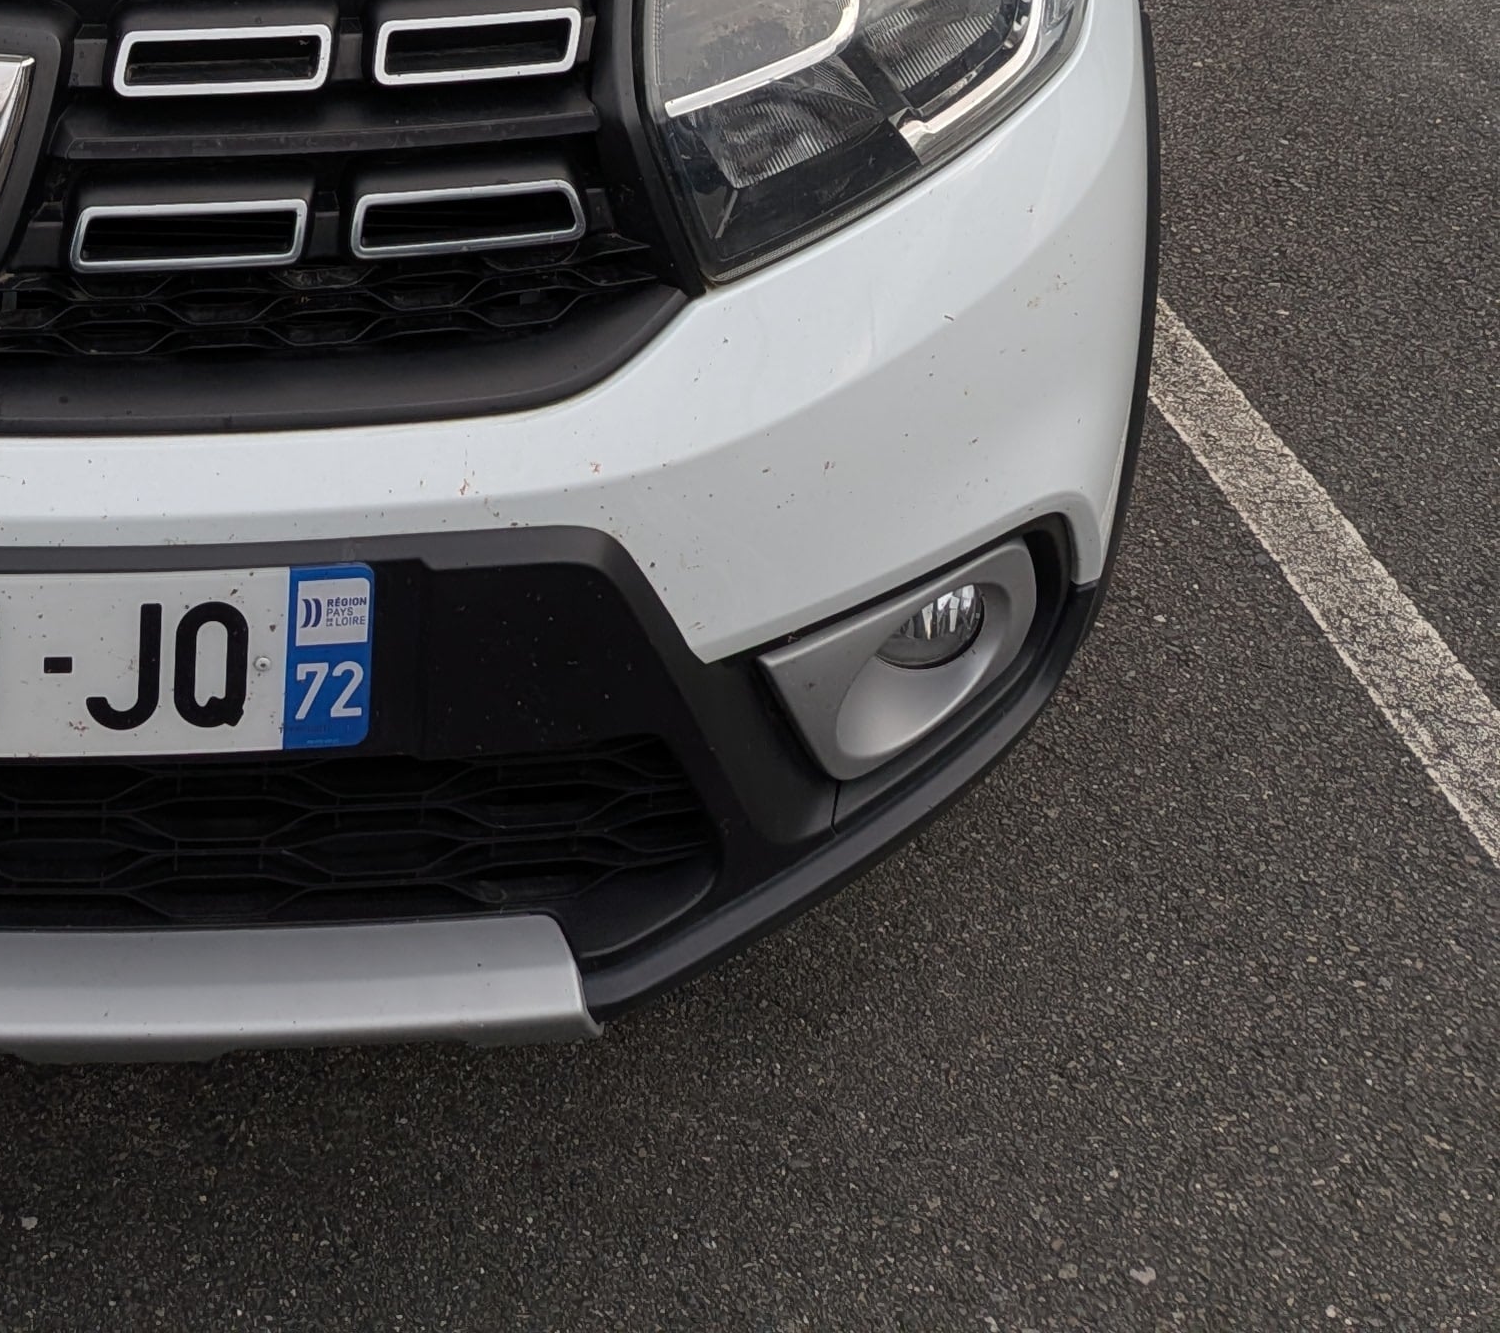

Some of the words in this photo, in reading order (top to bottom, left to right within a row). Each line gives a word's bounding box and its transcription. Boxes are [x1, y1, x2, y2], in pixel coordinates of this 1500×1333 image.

[326, 596, 367, 608] RÉGION
[326, 606, 354, 617] PAYS
[335, 615, 366, 627] LOIRE
[295, 660, 364, 721] 72
